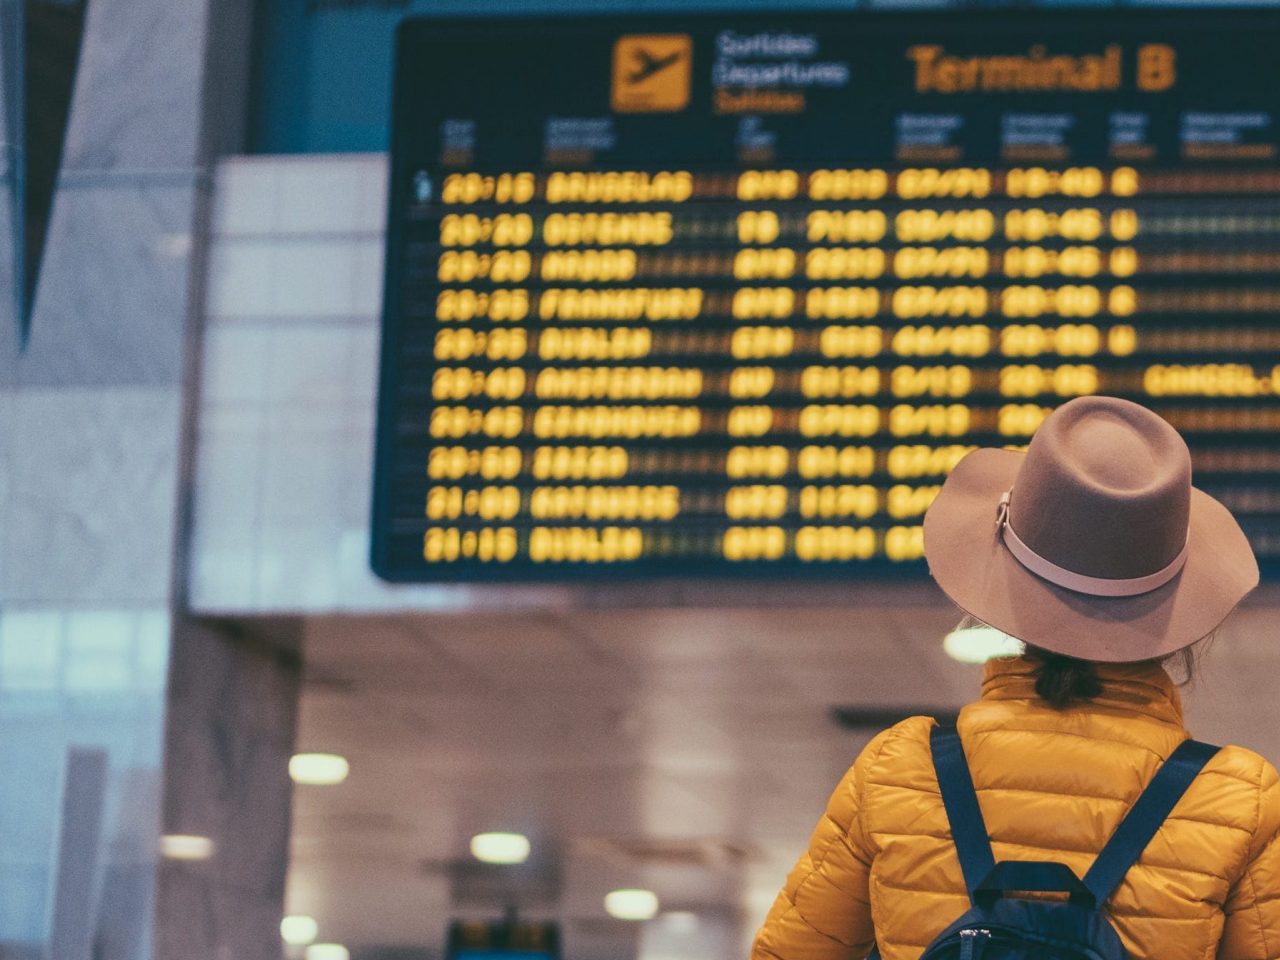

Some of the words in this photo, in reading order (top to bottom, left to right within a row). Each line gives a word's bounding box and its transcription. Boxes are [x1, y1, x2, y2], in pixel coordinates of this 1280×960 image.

[711, 57, 848, 88] Departures
[906, 44, 1123, 92] Terminal
[1136, 43, 1176, 92] B
